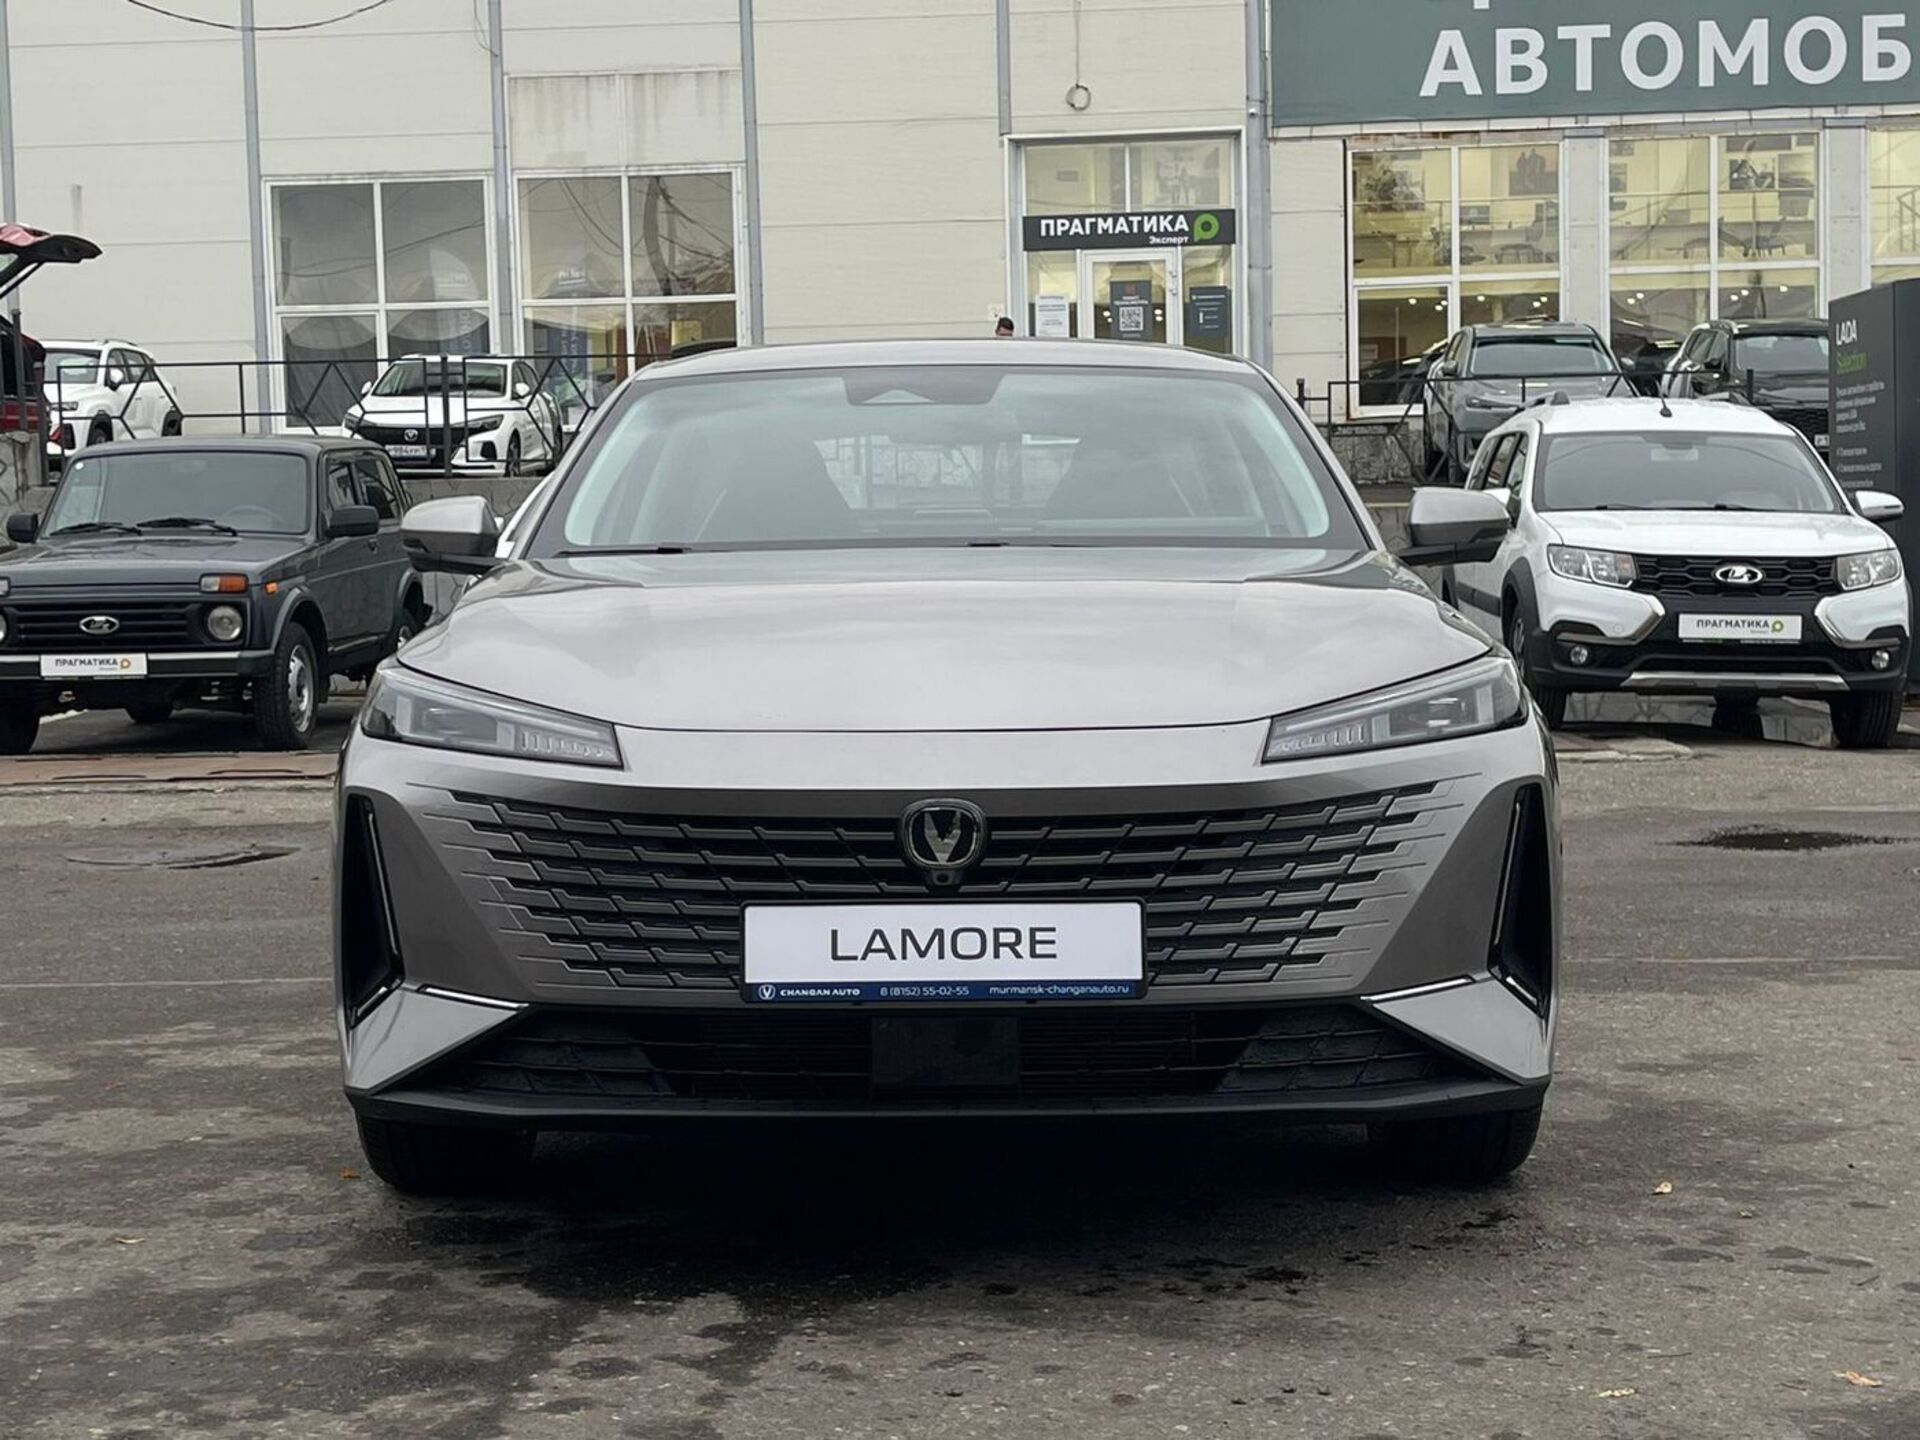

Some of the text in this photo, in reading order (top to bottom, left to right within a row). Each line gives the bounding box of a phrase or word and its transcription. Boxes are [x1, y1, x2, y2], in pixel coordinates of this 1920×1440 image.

[1419, 13, 1912, 97] АВТОМОБ
[1040, 214, 1189, 237] ПРАГМАТИКА
[1149, 235, 1189, 245] Эксперт
[1836, 319, 1857, 346] LADA
[1696, 619, 1770, 628] ПРАГМАТИКА
[55, 658, 118, 667] ПРАГМАТИКА
[830, 927, 1058, 961] LAMORE
[780, 987, 861, 997] CHANGAN AUTO
[880, 985, 970, 997] 8 (8152) 55-02-55
[989, 984, 1130, 997] murmansk-changanauto.ru
